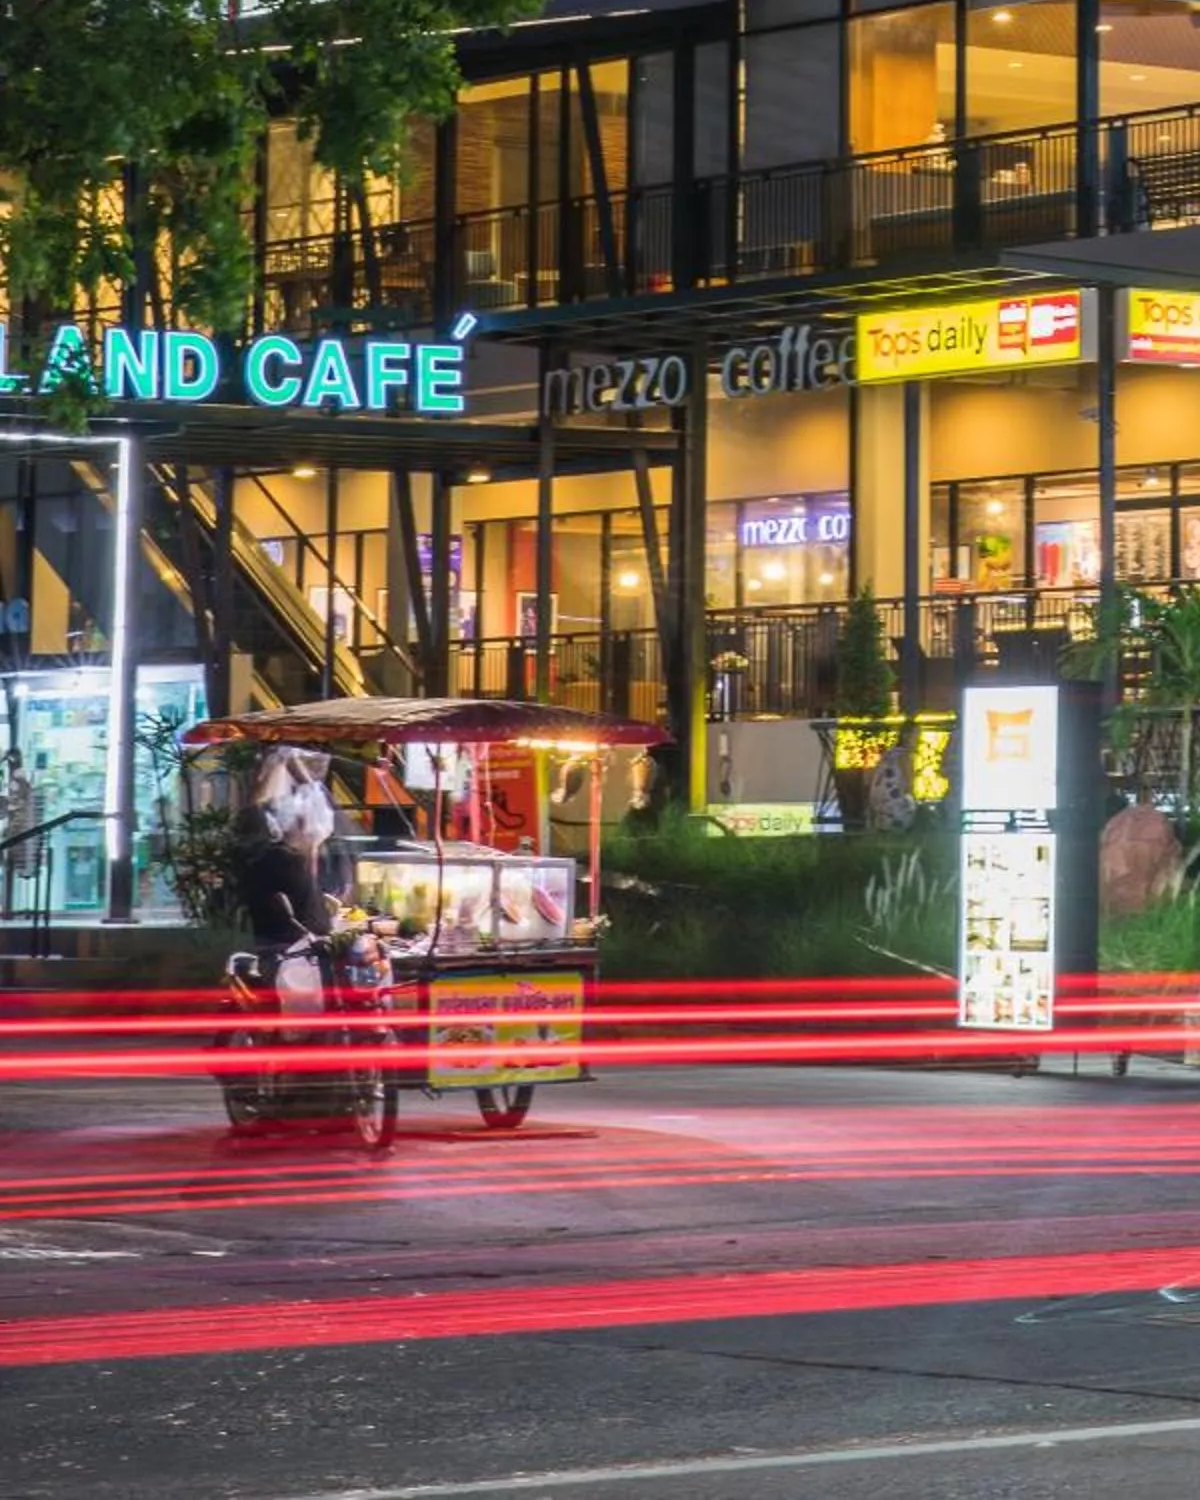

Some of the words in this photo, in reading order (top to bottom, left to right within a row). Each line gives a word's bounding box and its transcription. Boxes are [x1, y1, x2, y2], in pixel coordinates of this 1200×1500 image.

[866, 328, 921, 368] Tops
[927, 315, 988, 355] daily
[1137, 297, 1194, 332] Tops
[247, 312, 478, 413] CAFÉ
[544, 356, 686, 415] mezzo
[721, 324, 857, 397] coffee
